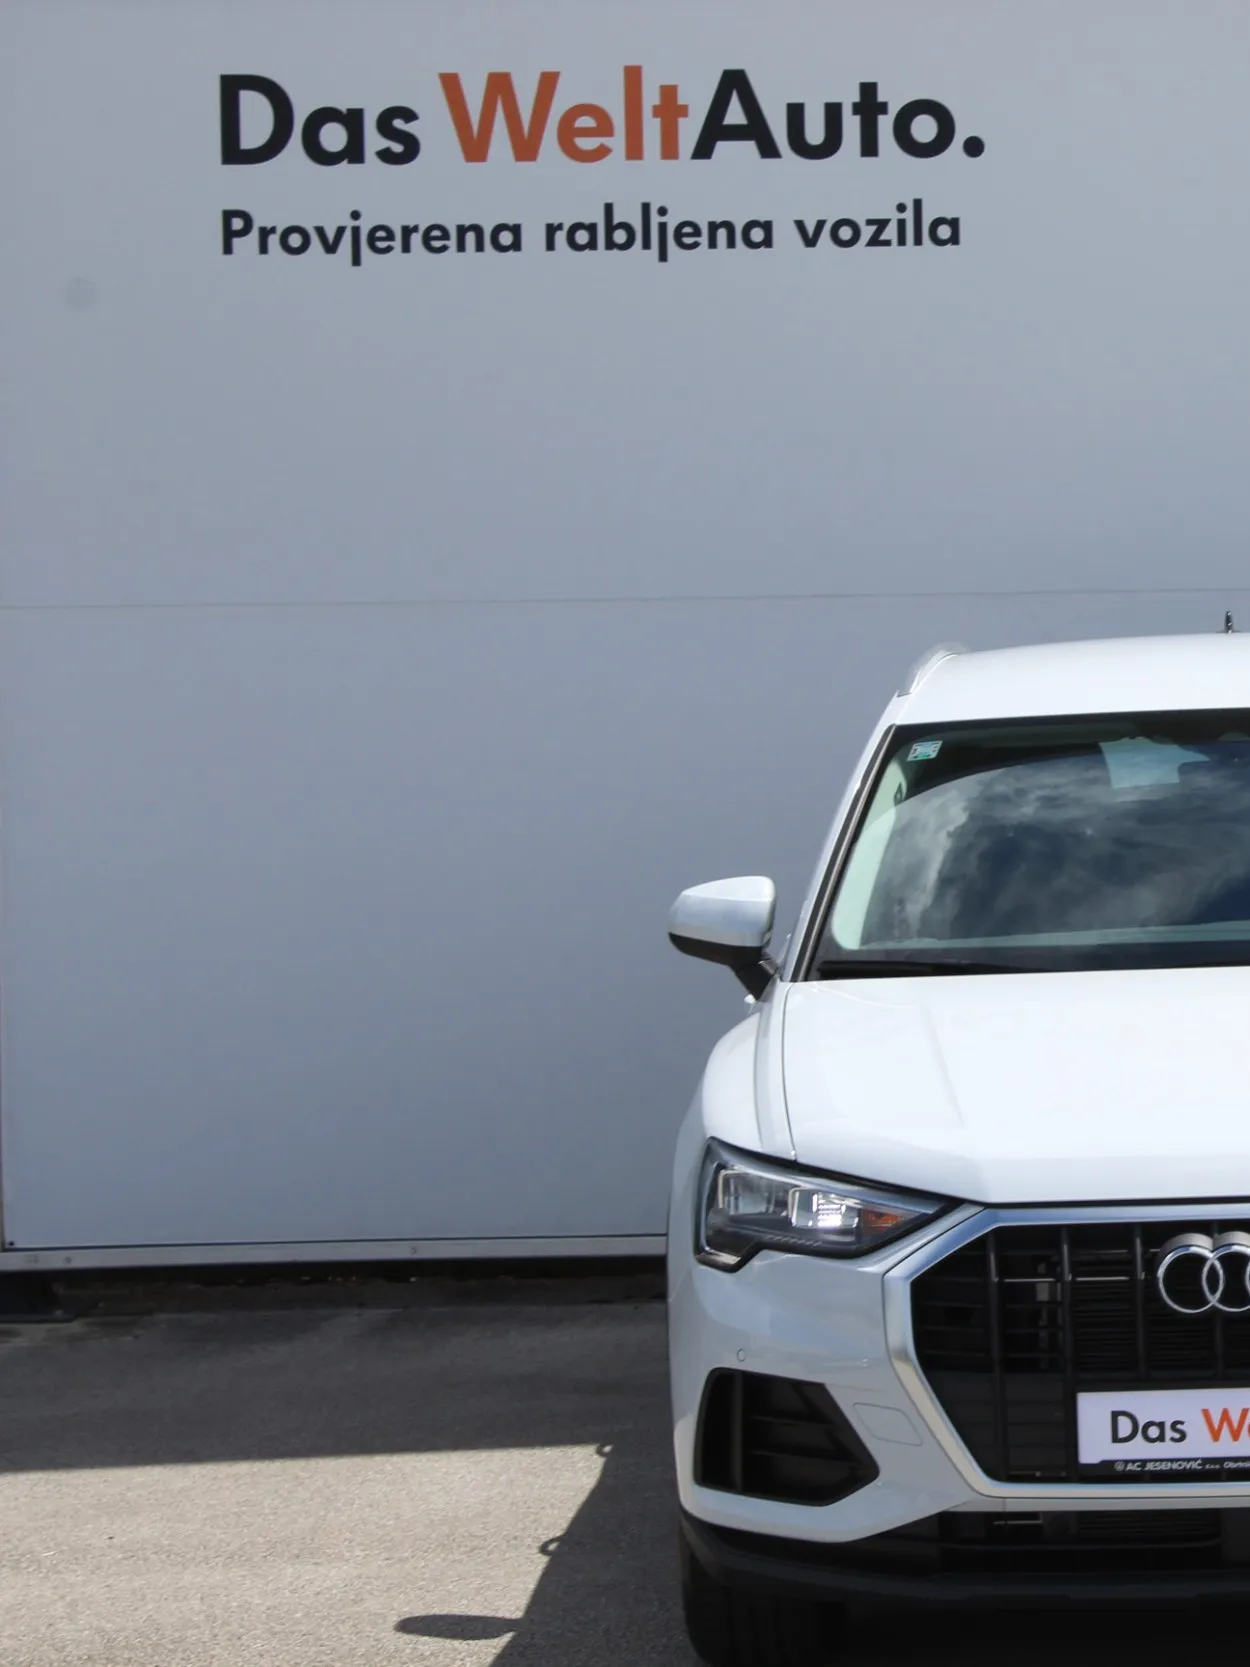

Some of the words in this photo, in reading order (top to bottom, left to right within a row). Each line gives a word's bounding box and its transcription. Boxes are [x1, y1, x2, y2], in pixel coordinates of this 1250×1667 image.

[220, 73, 420, 166] Das
[438, 65, 985, 163] WeltAuto.
[222, 208, 523, 267] Provjerena
[545, 202, 774, 263] rabljena
[794, 197, 961, 249] vozila
[1110, 1409, 1188, 1444] Das
[1126, 1461, 1142, 1471] AC
[1144, 1459, 1203, 1471] JESENOVIĆ
